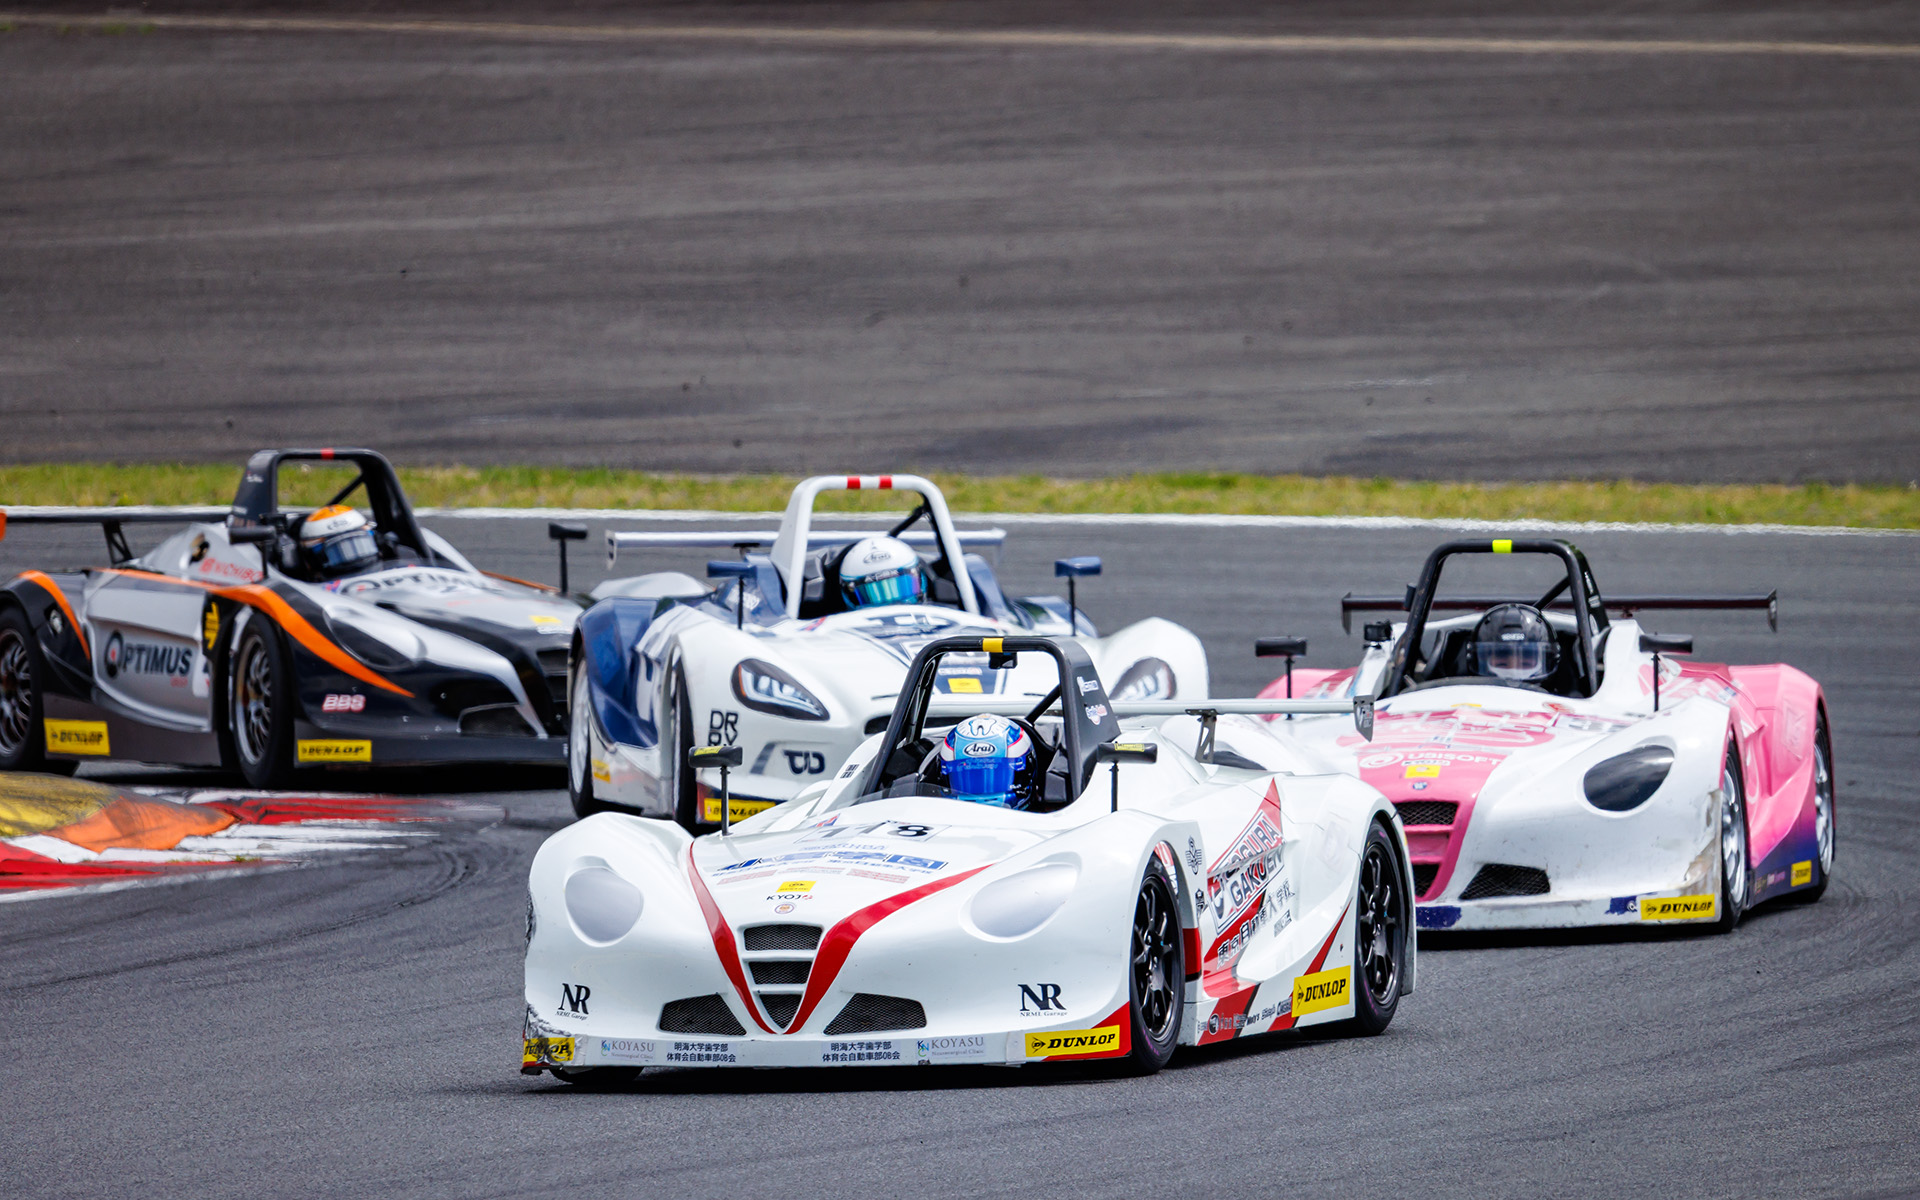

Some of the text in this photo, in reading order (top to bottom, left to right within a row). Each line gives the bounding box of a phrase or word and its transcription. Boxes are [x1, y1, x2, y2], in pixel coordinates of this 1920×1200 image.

[105, 630, 192, 679] OPTIMUS
[322, 694, 366, 710] BBS
[1408, 752, 1501, 766] UBISOFT
[713, 807, 766, 817] DNLO
[1230, 845, 1284, 908] GAKUEN
[1659, 901, 1713, 915] DUNLOP
[1017, 983, 1067, 1012] NR
[1304, 978, 1347, 1002] DUNLOP
[558, 983, 591, 1015] NR
[612, 1040, 655, 1052] KOYASU
[931, 1037, 984, 1049] KOYASU
[1047, 1033, 1116, 1049] DUNLOP
